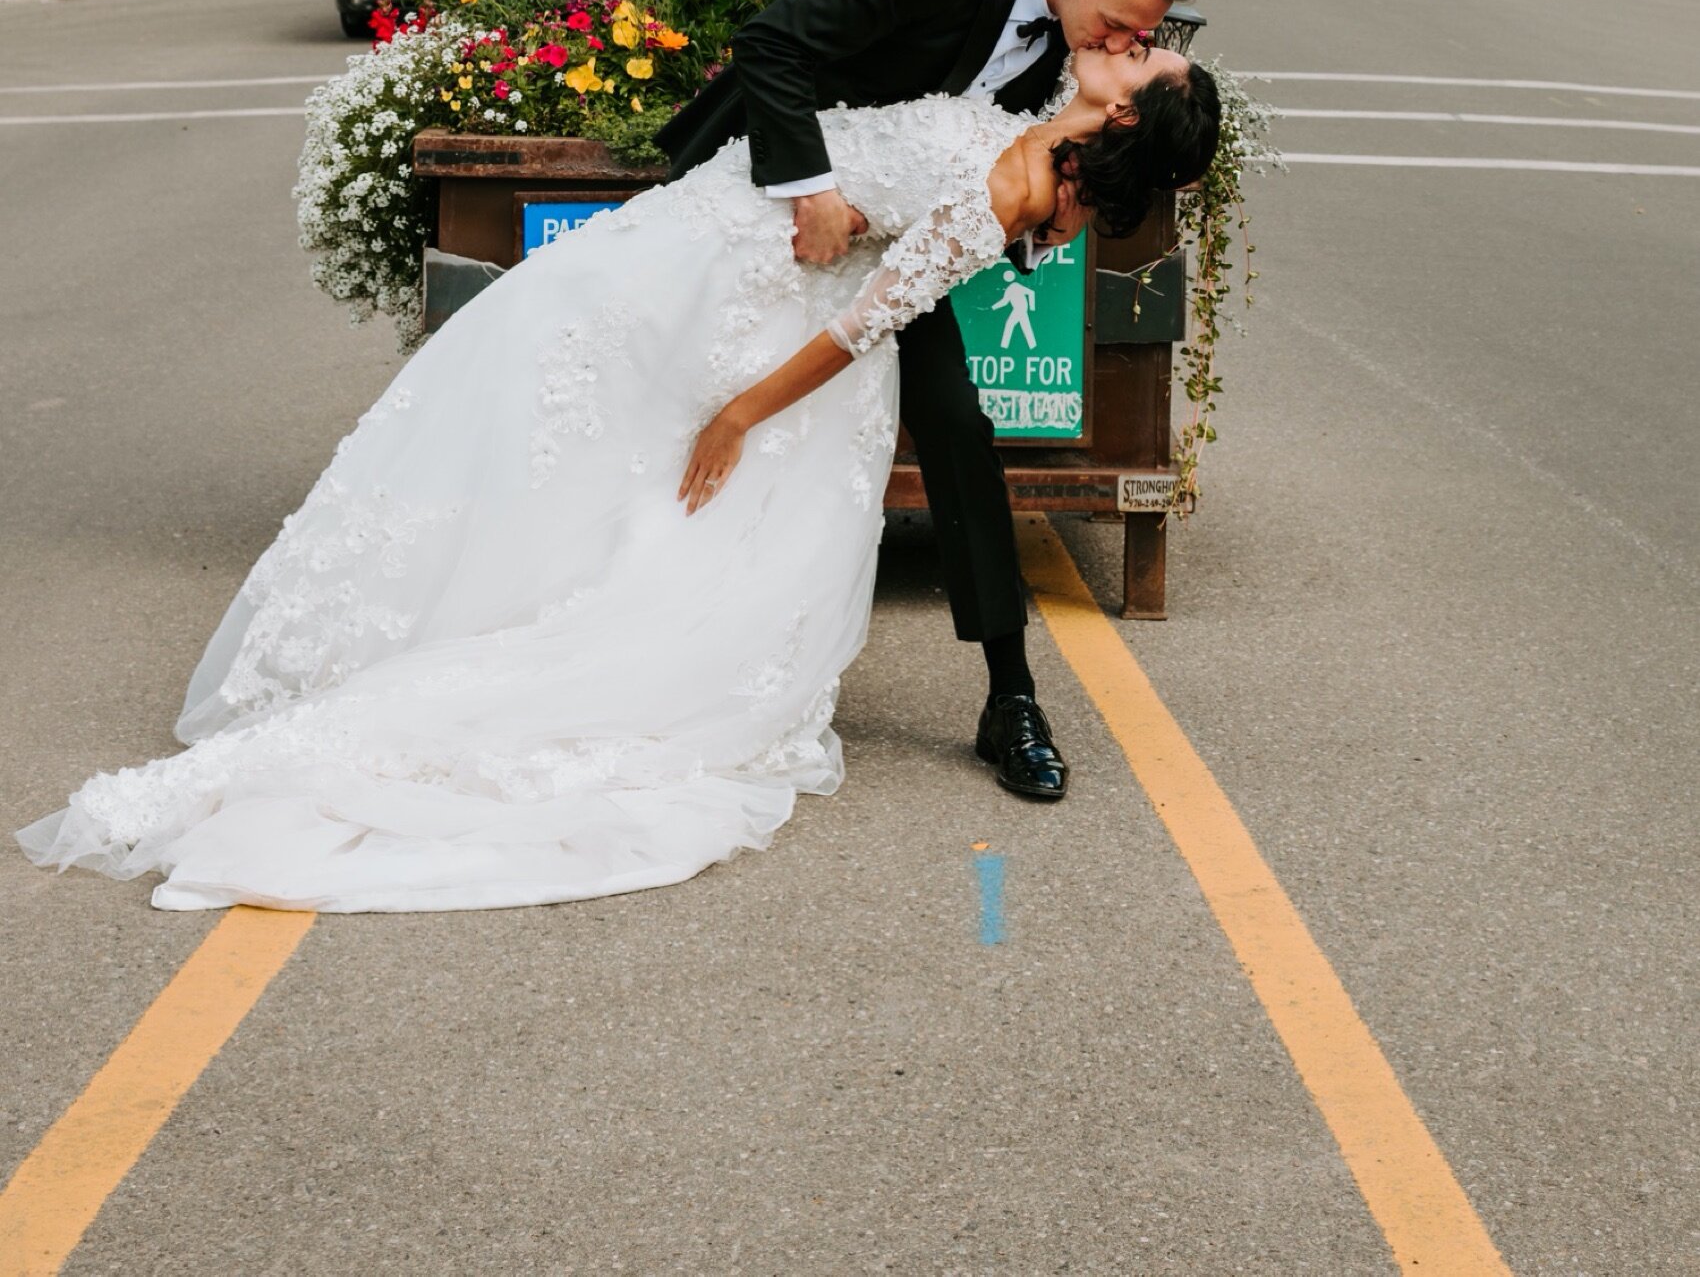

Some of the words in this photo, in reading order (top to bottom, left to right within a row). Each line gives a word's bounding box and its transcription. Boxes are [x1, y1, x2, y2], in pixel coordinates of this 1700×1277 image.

[968, 356, 1015, 385] TOP
[1026, 356, 1072, 385] FOR
[979, 390, 1083, 427] ESTRIANS
